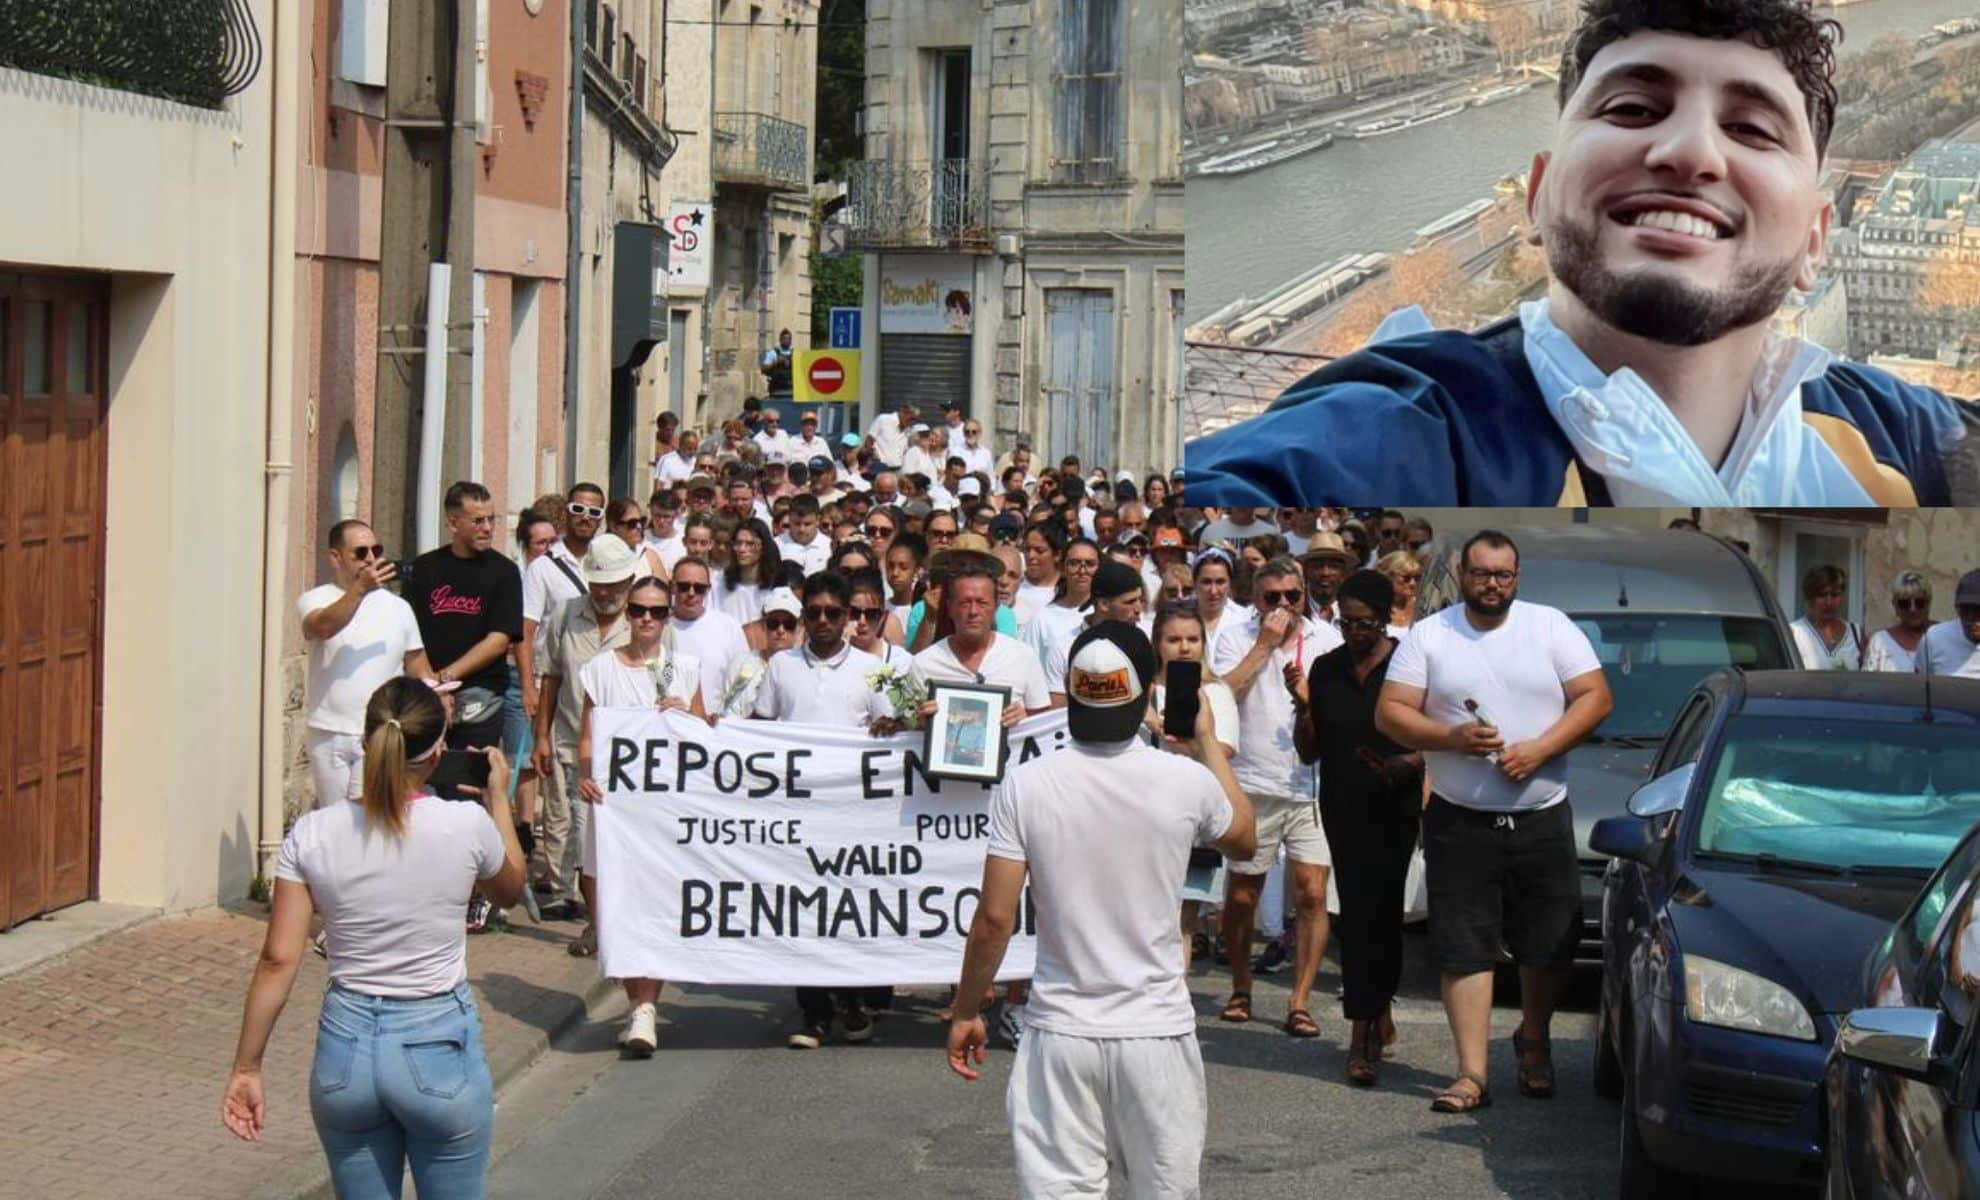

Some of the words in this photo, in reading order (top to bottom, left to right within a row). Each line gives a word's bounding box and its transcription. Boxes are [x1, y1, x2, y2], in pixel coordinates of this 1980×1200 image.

[431, 585, 482, 614] Gucci
[608, 737, 812, 798] REPOSE
[861, 748, 940, 799] EN
[917, 813, 989, 841] POUR
